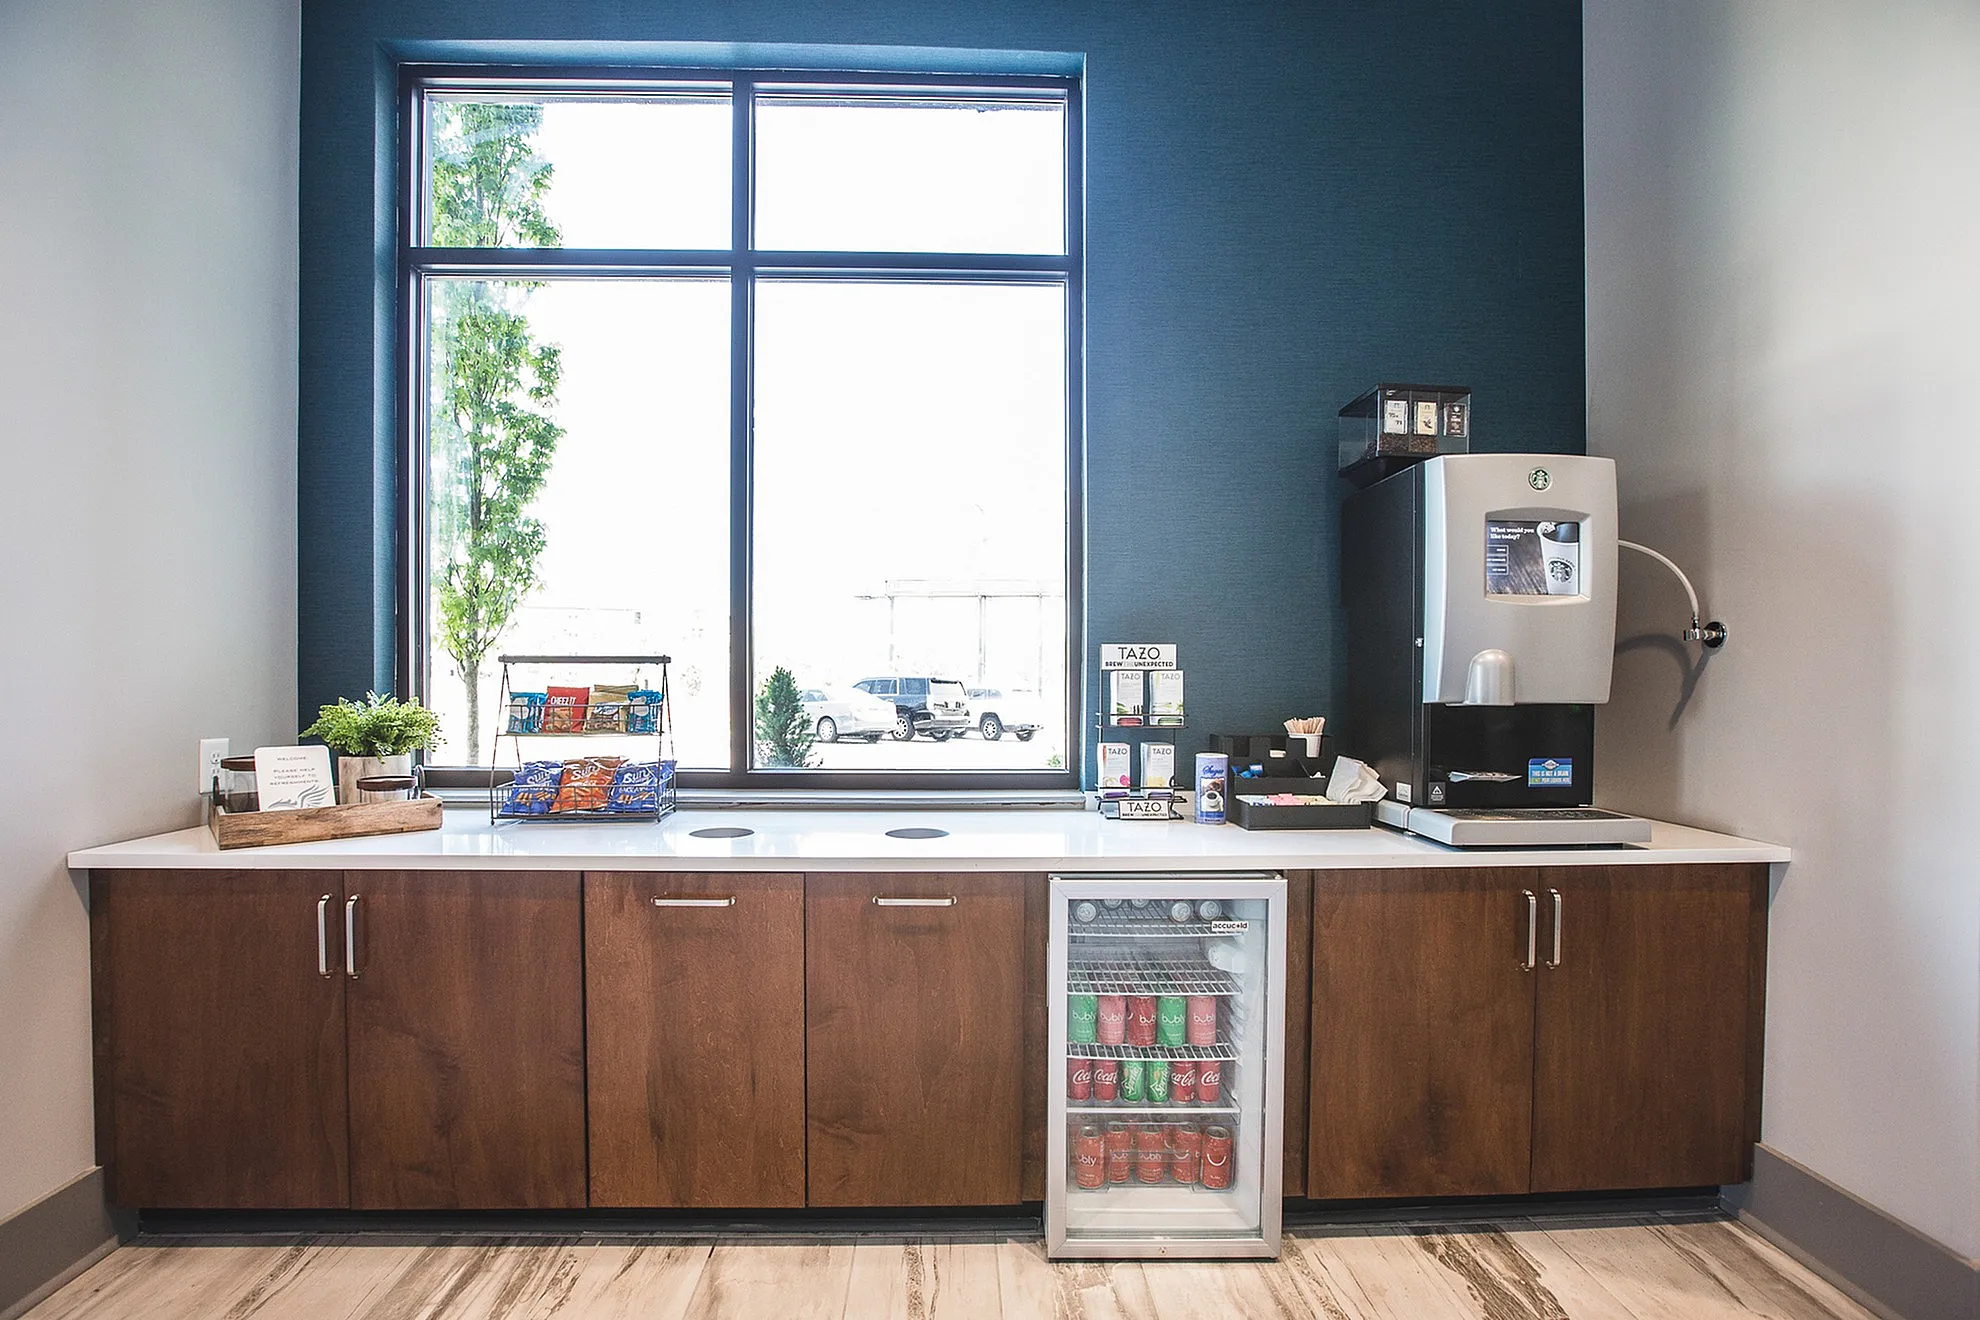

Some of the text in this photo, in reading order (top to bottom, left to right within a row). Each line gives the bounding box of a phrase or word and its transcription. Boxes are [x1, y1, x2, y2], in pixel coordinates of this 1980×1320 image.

[1502, 533, 1520, 541] today?
[1118, 647, 1160, 660] TAZO
[1202, 765, 1225, 777] Sugar
[1127, 802, 1161, 812] TAZO
